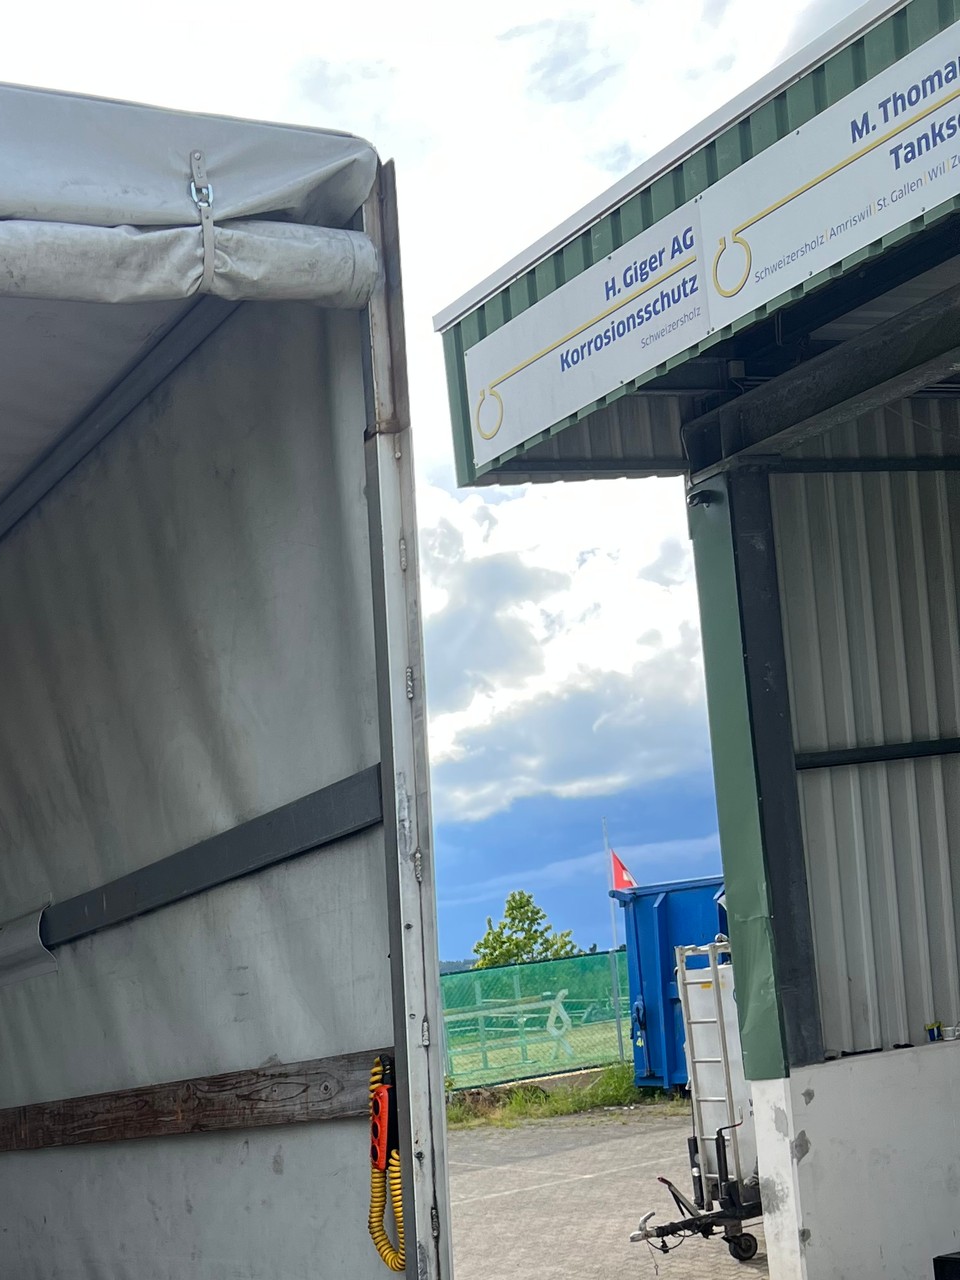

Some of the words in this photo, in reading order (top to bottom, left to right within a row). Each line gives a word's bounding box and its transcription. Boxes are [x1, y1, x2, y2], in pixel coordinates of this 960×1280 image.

[851, 110, 877, 144] M.
[878, 56, 960, 124] Thoma
[889, 113, 960, 171] Tanks
[754, 233, 825, 284] Schweizersholz
[829, 204, 873, 240] Amriswil
[876, 198, 890, 212] St.
[890, 176, 923, 203] Gallen
[927, 161, 946, 182] Wil
[604, 276, 621, 301] H.
[622, 247, 665, 288] Giger
[670, 226, 695, 260] AG
[560, 274, 699, 372] Korrosionsschutz
[641, 306, 701, 349] Schweizersholz
